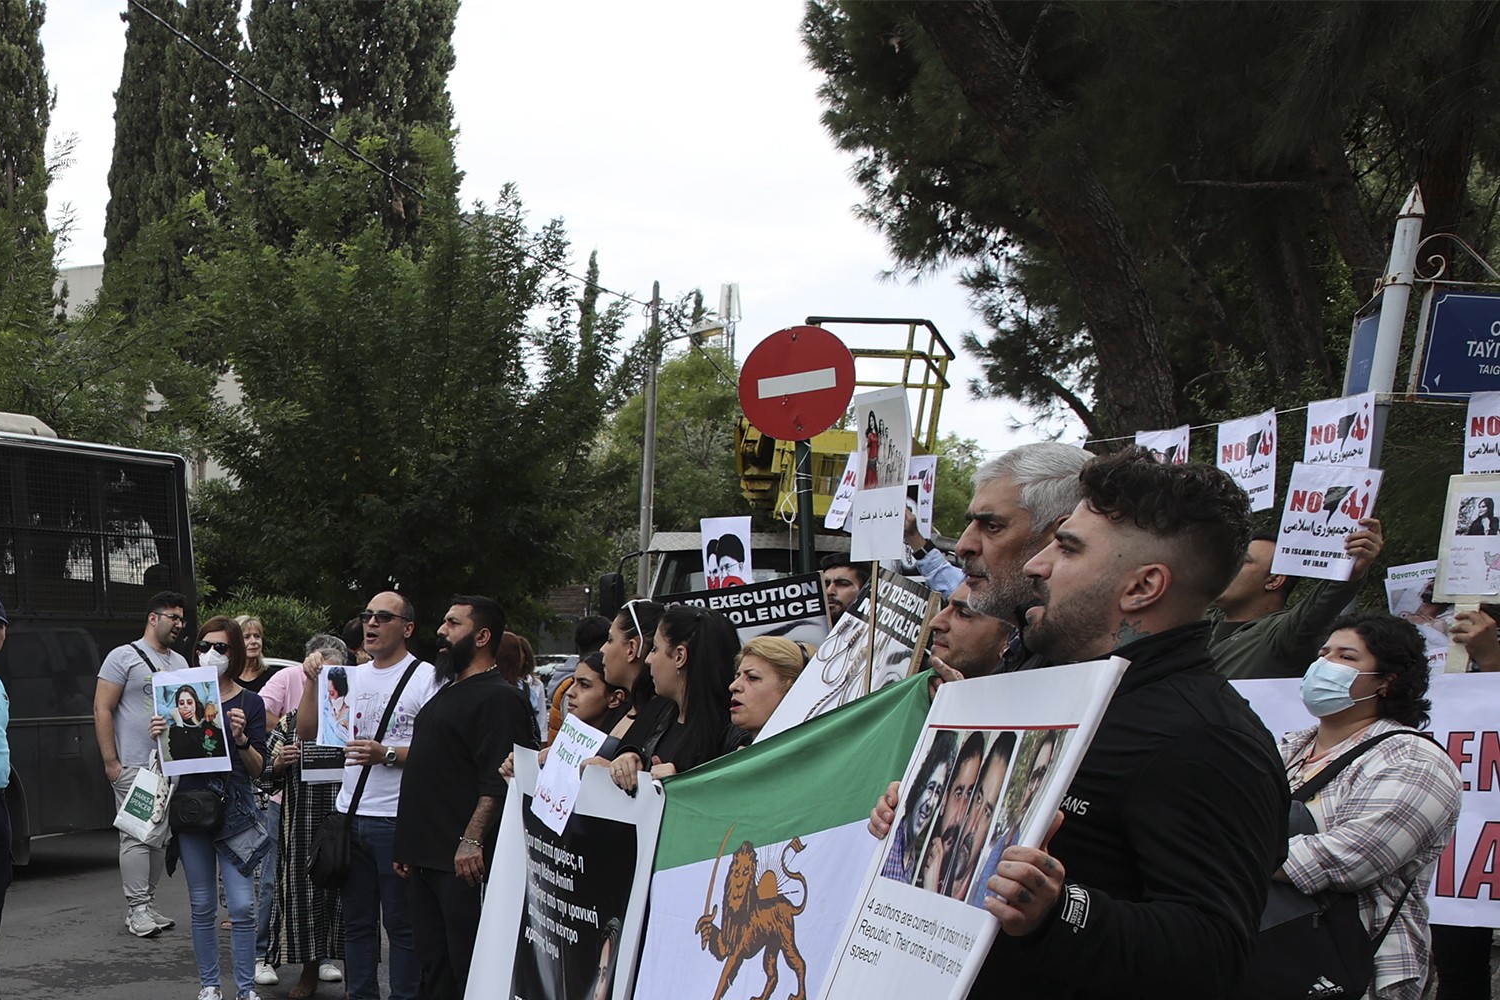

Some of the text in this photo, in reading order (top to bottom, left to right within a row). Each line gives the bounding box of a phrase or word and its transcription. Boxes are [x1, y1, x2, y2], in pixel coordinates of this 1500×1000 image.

[1350, 402, 1369, 441] نه
[1471, 416, 1500, 437] NO
[1258, 419, 1273, 456] نه
[1310, 423, 1337, 446] NO
[1222, 442, 1246, 464] NO
[1290, 490, 1323, 514] NO
[1341, 479, 1371, 520] نه
[1283, 519, 1314, 534] اسلامی
[1291, 548, 1319, 557] ISLAMIC
[1320, 550, 1352, 560] REPUBLIC
[1302, 559, 1328, 568] OF IRAN
[709, 580, 819, 610] EXECUTION
[726, 598, 821, 625] OLENCE
[1427, 731, 1500, 791] EN
[130, 798, 152, 813] SPENCER
[1060, 794, 1090, 816] ANS
[556, 870, 574, 892] Amini
[568, 903, 599, 929] ιρανική
[867, 897, 875, 912] 4
[874, 903, 901, 922] authors
[900, 912, 913, 926] are
[556, 919, 579, 945] κέντρο
[858, 919, 891, 945] Republic.
[893, 931, 911, 952] Their
[849, 944, 881, 966] speech!
